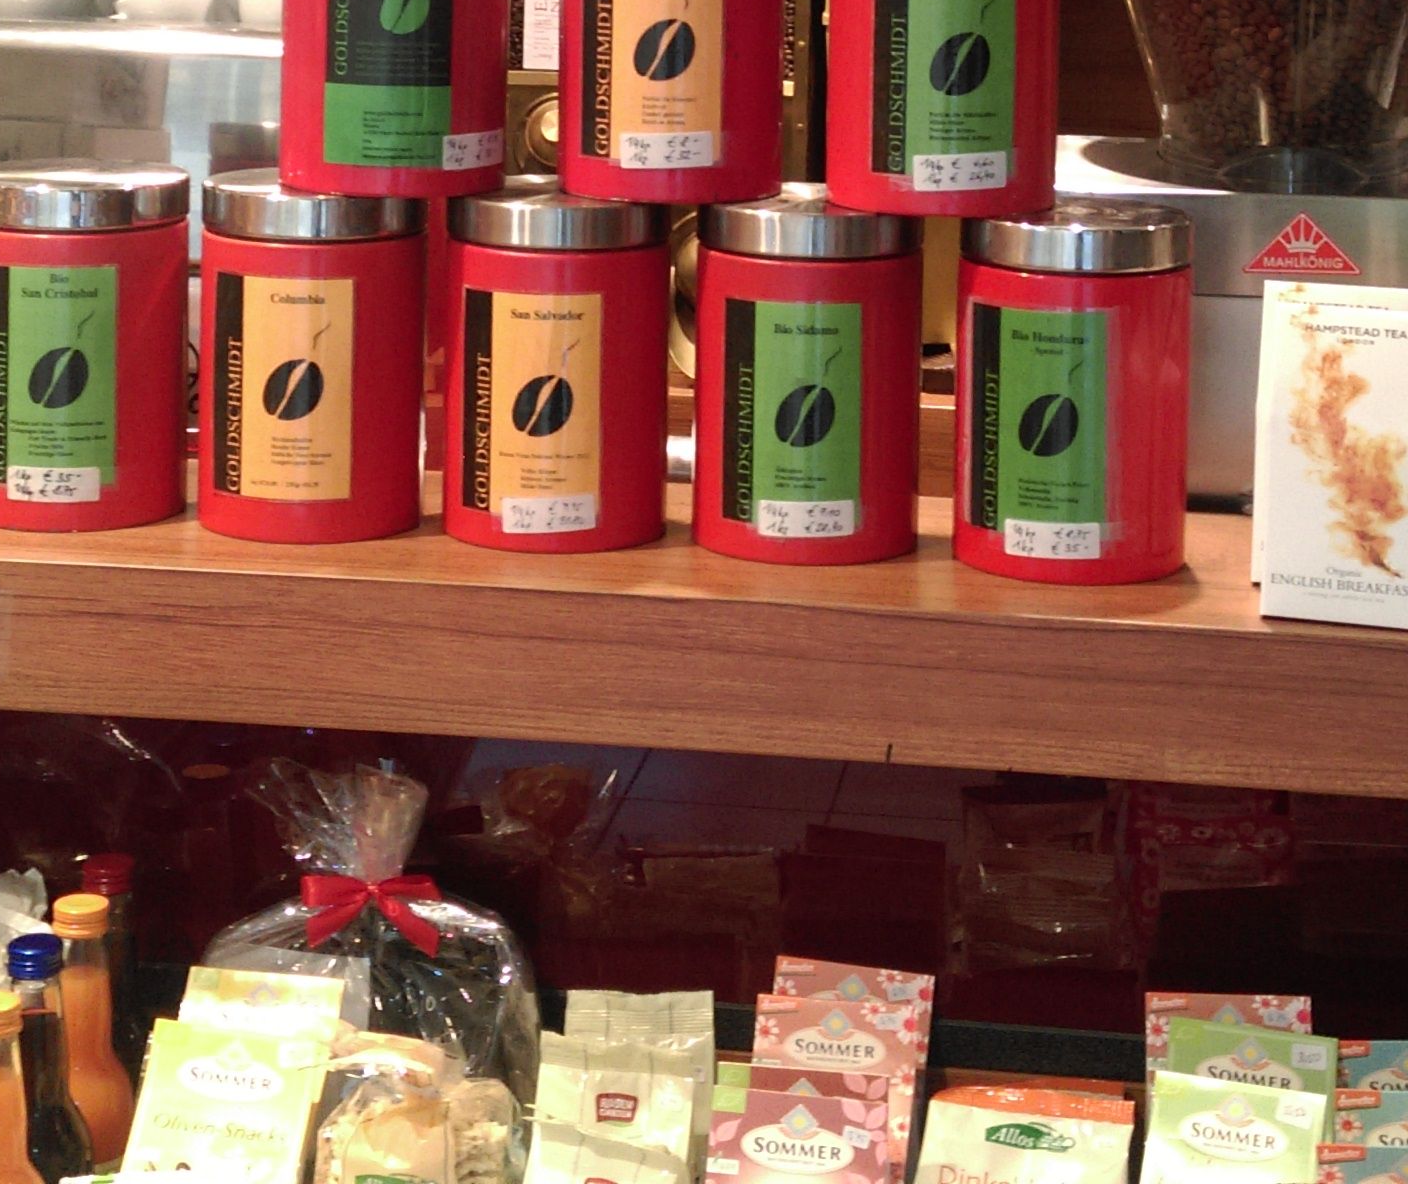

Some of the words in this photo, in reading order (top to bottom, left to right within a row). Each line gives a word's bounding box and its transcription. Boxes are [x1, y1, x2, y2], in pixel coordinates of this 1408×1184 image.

[595, 0, 613, 156] GOLDSCHMIDT
[888, 15, 907, 172] GOLDSCHMIDT
[1263, 253, 1344, 269] MAHLKÖNIG
[49, 273, 69, 285] Bio
[21, 288, 42, 299] San
[45, 288, 99, 300] Cristobal
[270, 292, 326, 305] Columbia
[510, 309, 530, 320] San
[534, 309, 585, 321] Salvador
[774, 324, 792, 335] Bio
[795, 324, 840, 335] Sidamo
[1011, 329, 1030, 341] Bio
[1305, 323, 1380, 338] HAMPSTEAD
[1384, 328, 1408, 339] TEA
[226, 336, 243, 492] GOLDSCHMIDT
[475, 353, 491, 509] GOLDSCHMIDT
[738, 363, 754, 520] GOLDSCHMIDT
[983, 368, 1000, 528] GOLDSCHMIDT
[1270, 572, 1332, 590] ENGLISH
[1326, 566, 1361, 578] Organic
[794, 1038, 876, 1059] SOMMER
[190, 1066, 273, 1090] SOMMER
[991, 1127, 1036, 1148] Allos
[1191, 1122, 1276, 1150] SOMMER
[753, 1136, 842, 1161] SOMMER
